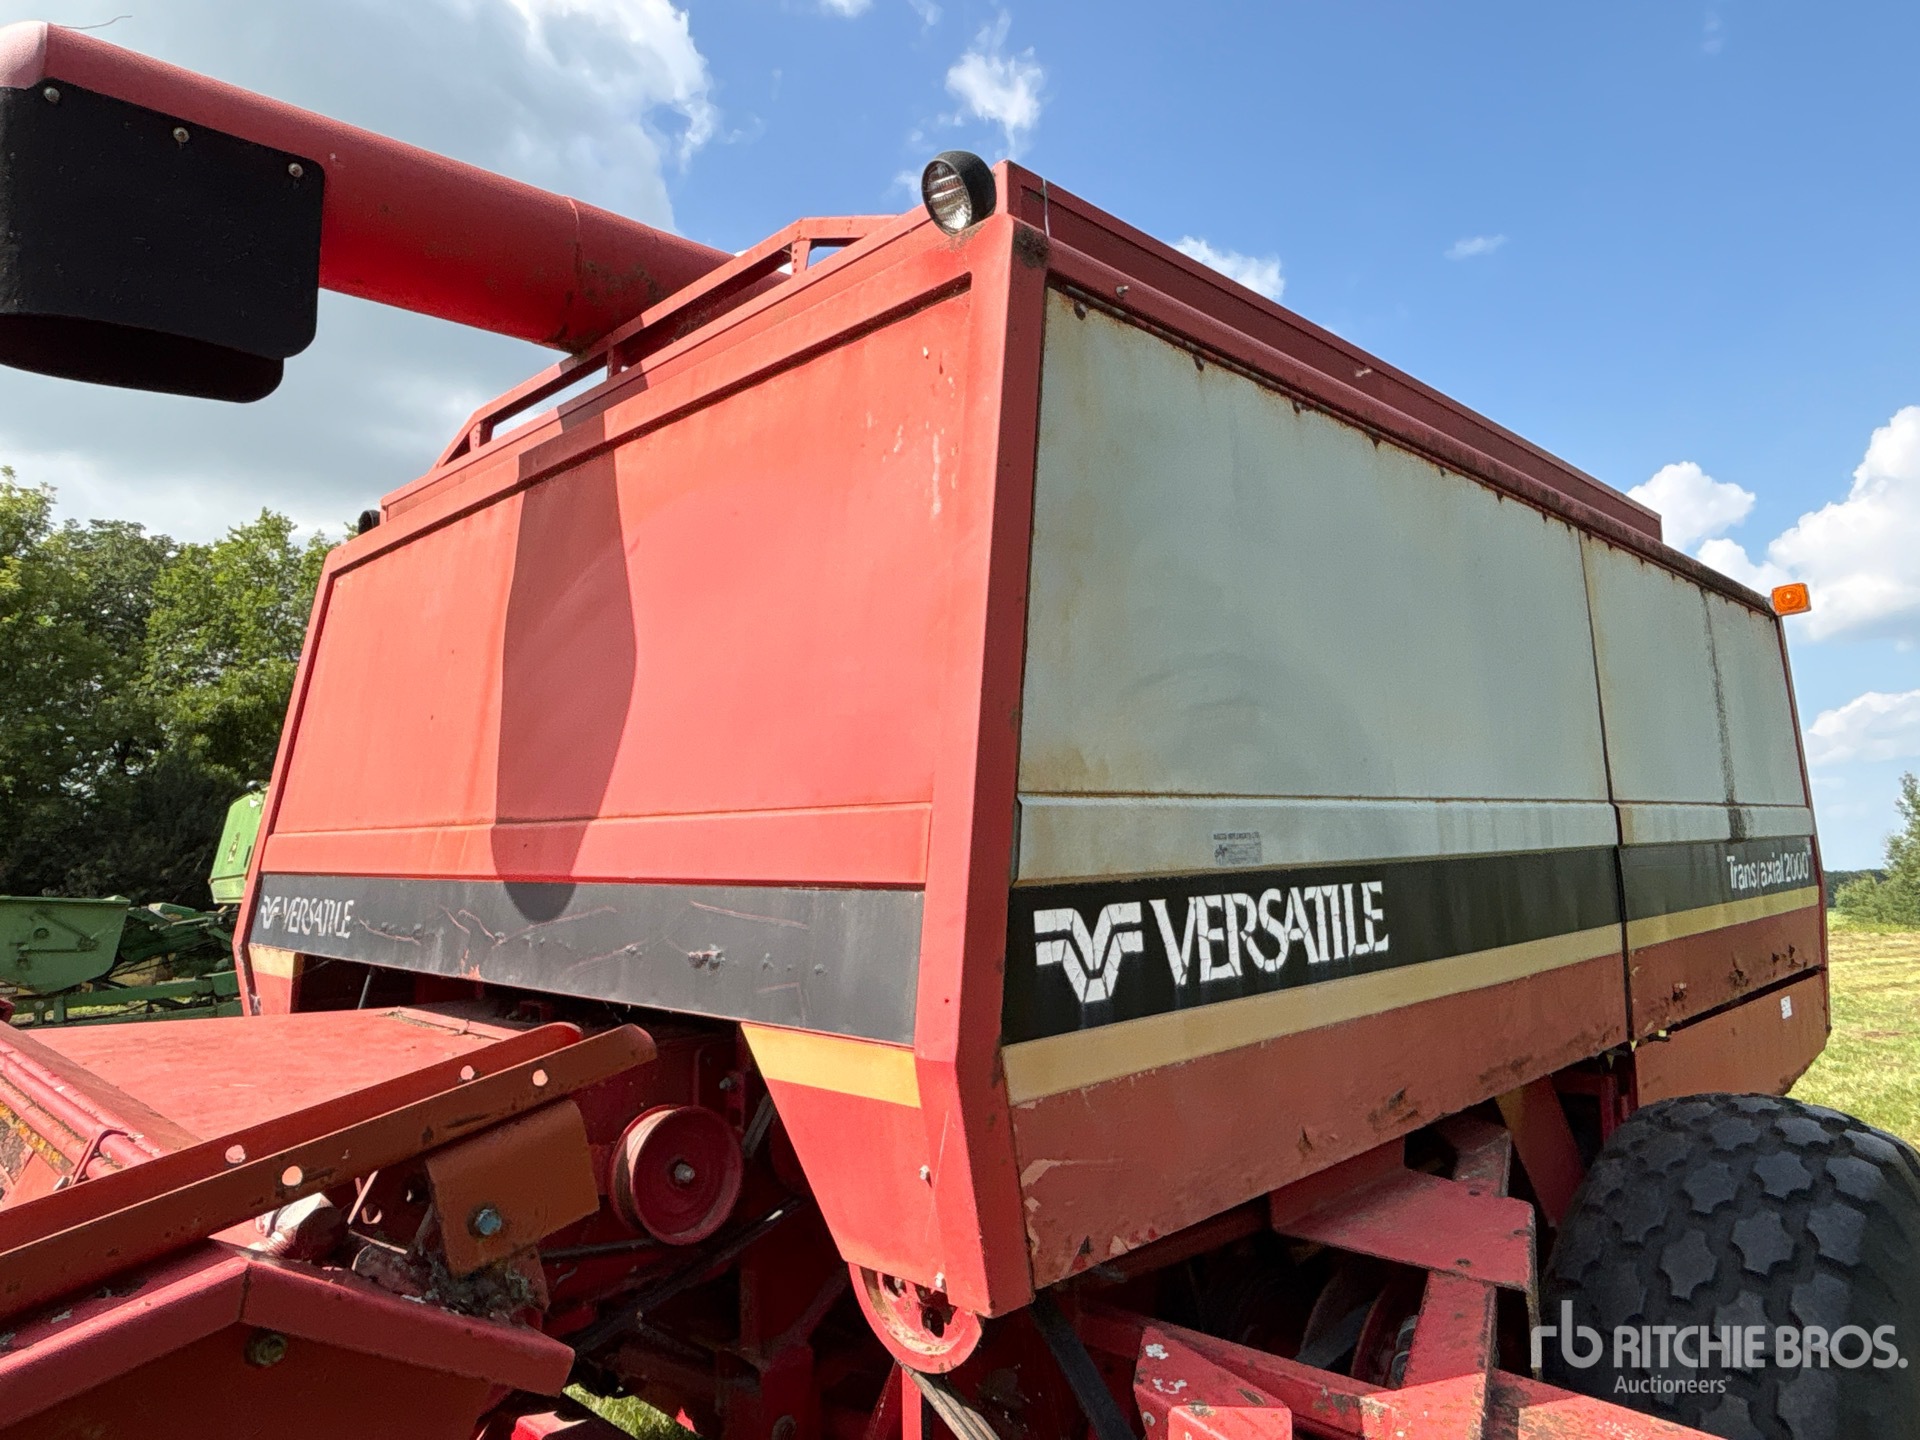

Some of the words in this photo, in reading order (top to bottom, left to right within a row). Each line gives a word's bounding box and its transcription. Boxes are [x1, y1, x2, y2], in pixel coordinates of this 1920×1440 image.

[1784, 851, 1809, 882] 2000
[283, 896, 354, 938] VERSATILE
[1148, 880, 1389, 985] VERSATILE
